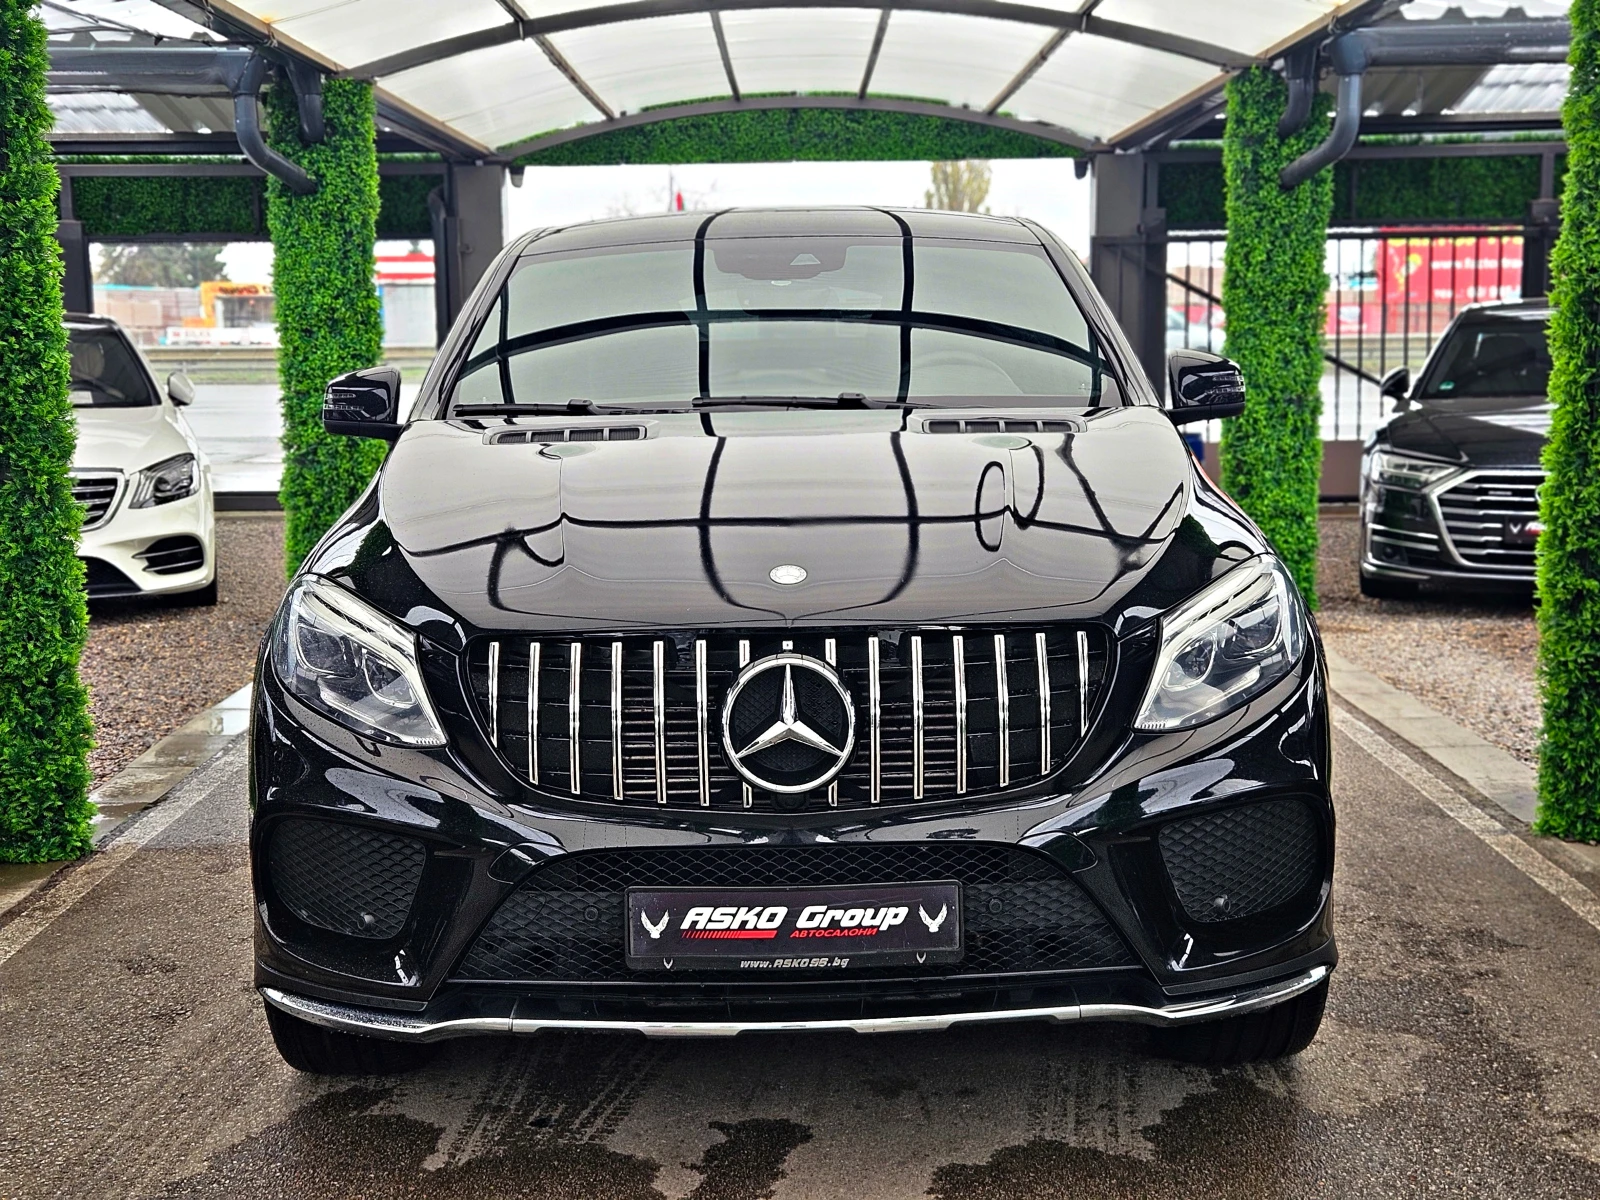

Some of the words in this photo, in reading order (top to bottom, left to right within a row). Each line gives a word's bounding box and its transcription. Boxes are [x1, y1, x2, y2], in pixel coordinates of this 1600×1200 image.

[680, 906, 788, 930] ASKO
[796, 905, 909, 931] Group
[789, 927, 878, 938] АВТОСАЛОНИ
